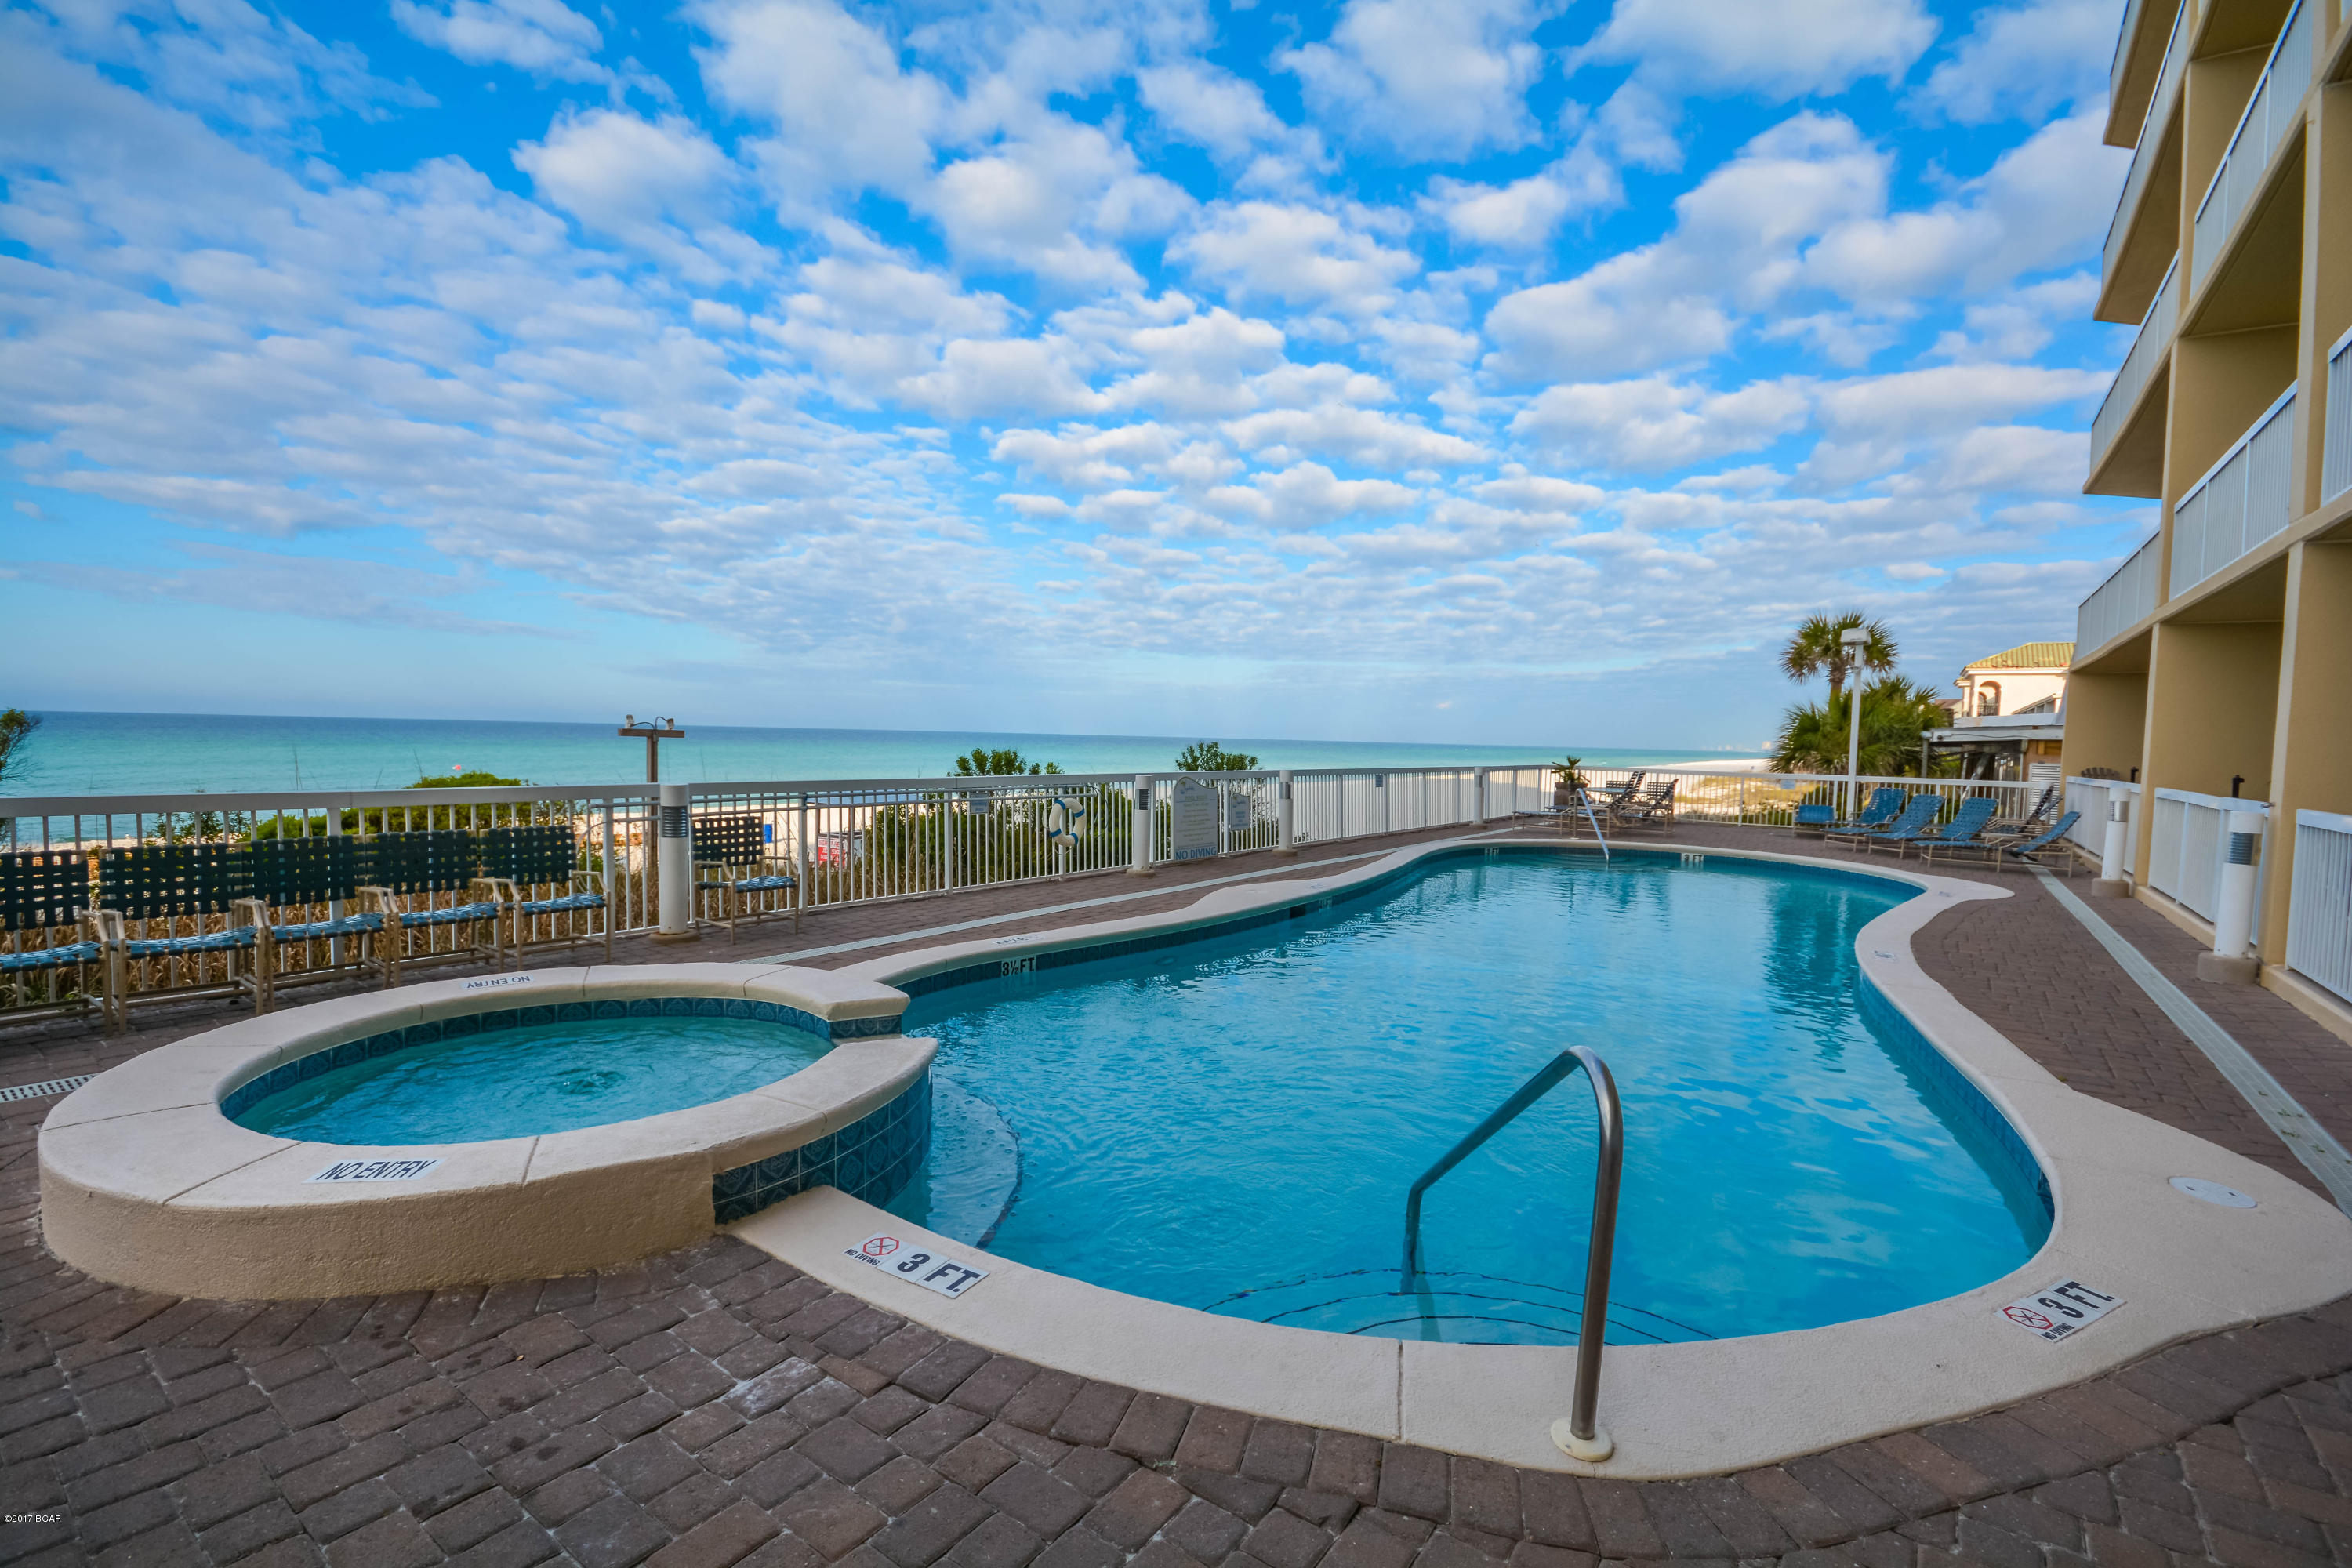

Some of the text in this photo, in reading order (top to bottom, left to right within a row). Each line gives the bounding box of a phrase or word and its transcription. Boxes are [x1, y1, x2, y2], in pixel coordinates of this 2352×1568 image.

[1176, 847, 1217, 860] NO DIVING
[466, 978, 508, 988] ENTRY
[315, 1160, 437, 1180] NO ENTRY
[855, 1253, 881, 1266] DIVING
[897, 1254, 982, 1293] 3 FT.
[2038, 1281, 2115, 1319] 3 FT.
[2041, 1323, 2076, 1341] NO DIVING
